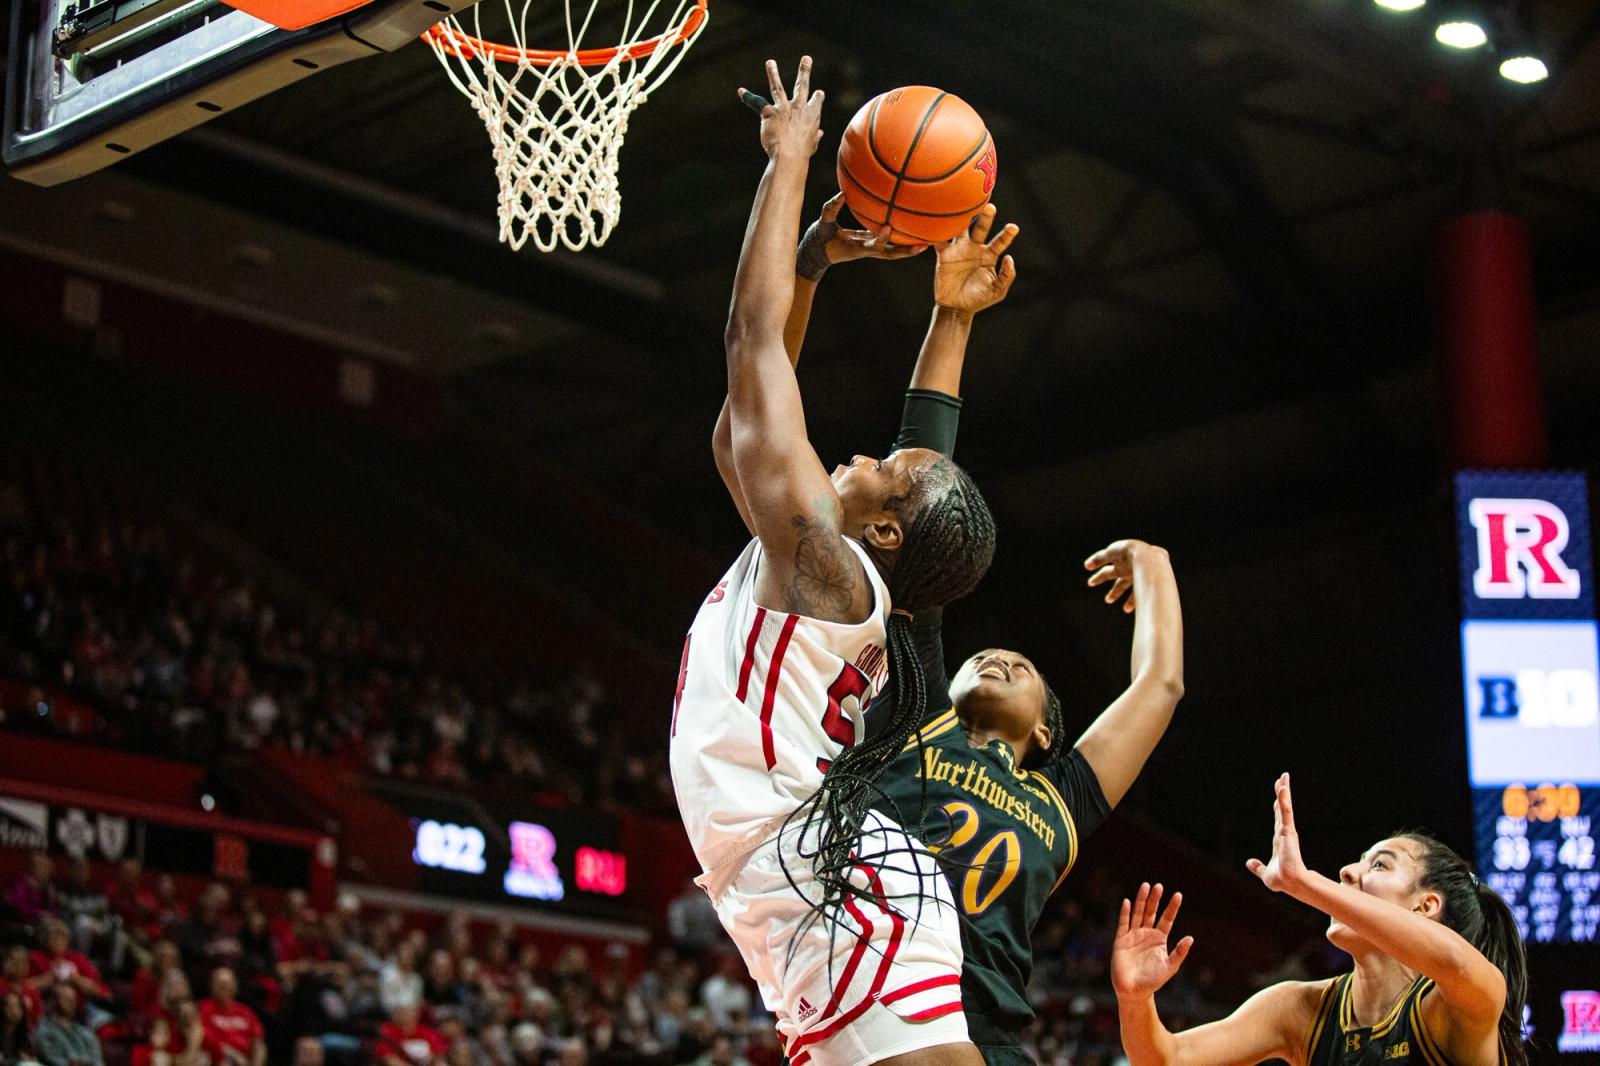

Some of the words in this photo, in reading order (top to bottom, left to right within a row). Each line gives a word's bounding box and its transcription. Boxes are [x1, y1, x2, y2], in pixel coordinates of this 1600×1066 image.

[1469, 498, 1581, 599] R
[915, 746, 1056, 851] Northwestern
[927, 800, 1023, 916] 20
